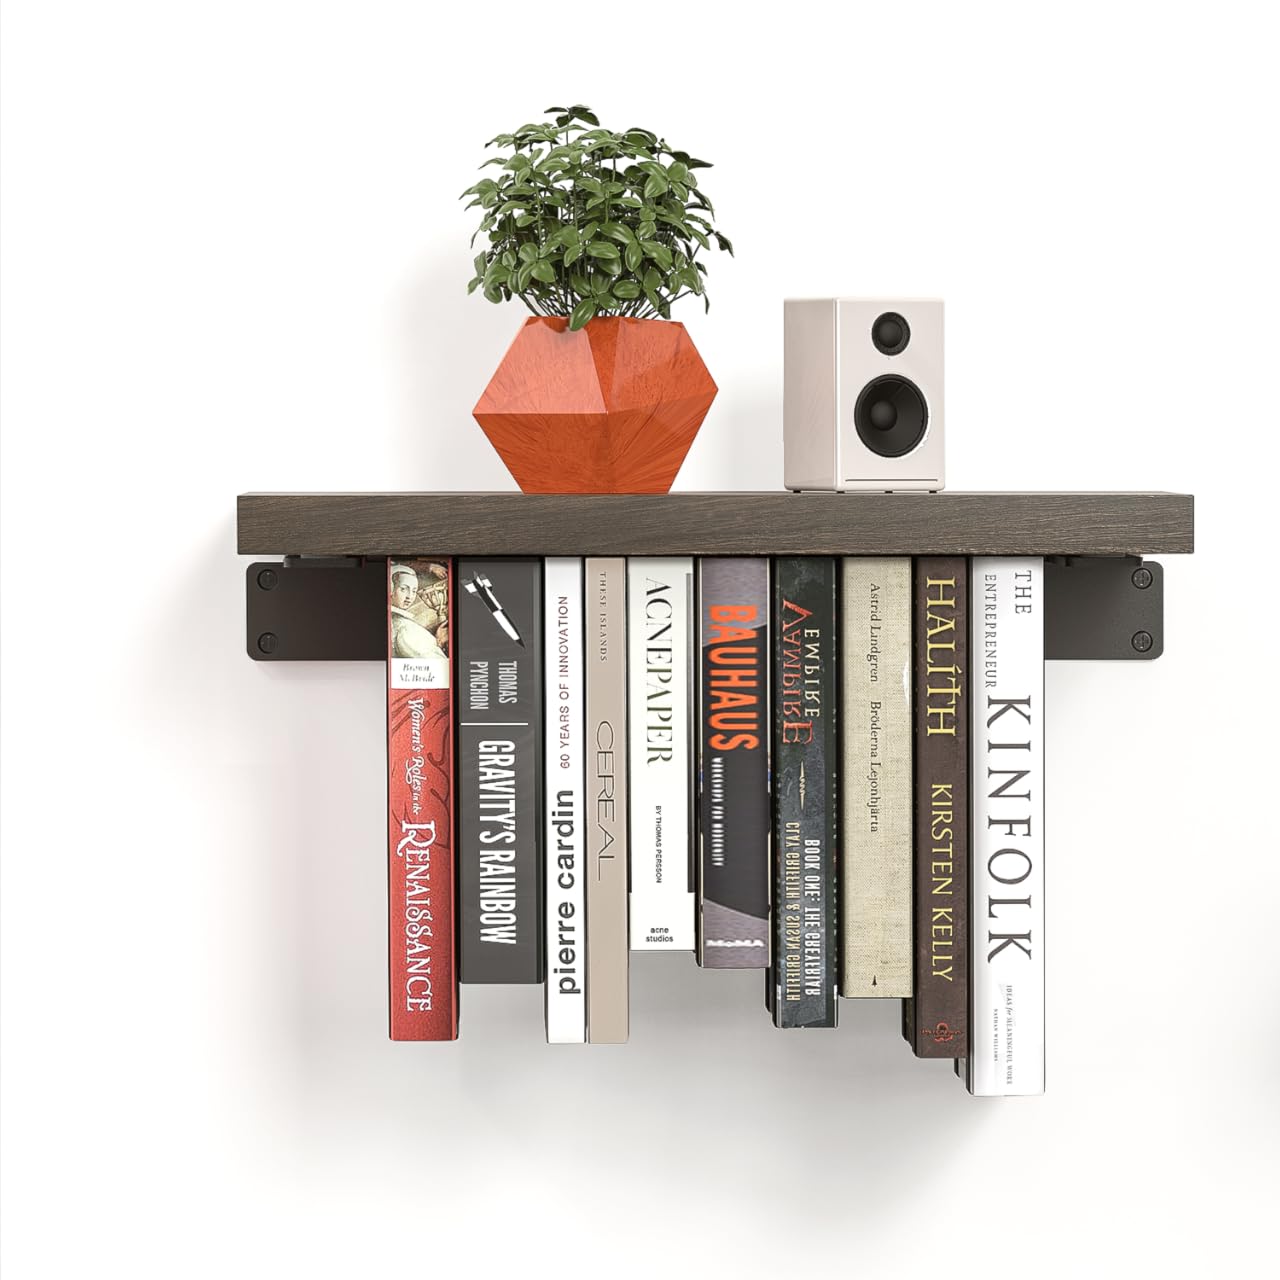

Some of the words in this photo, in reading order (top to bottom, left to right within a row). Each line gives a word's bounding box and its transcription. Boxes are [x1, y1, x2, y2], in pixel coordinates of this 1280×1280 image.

[599, 571, 607, 608] THESE
[870, 583, 882, 622] Astrid
[1014, 570, 1032, 614] THE
[558, 596, 569, 678] INNOVATION
[868, 626, 882, 682] Lindgren
[984, 574, 996, 688] ENTREPRENEUR
[470, 661, 489, 709] PYNCHON
[498, 661, 518, 703] THOMAS
[559, 683, 569, 700] OF
[645, 577, 673, 766] ACNEPAPER
[708, 604, 759, 750] BAUHAUS
[408, 697, 426, 752] Women's
[559, 706, 570, 748] YEARS
[870, 701, 882, 757] Bröderna
[405, 756, 426, 791] Roles
[561, 755, 570, 769] 60
[413, 792, 422, 801] in
[413, 803, 422, 815] the
[596, 721, 615, 881] CEREAL
[656, 805, 662, 815] BY
[711, 806, 724, 822] FOR
[867, 762, 882, 832] Lejonhjärta
[552, 791, 574, 889] cardin
[931, 784, 952, 895] KIRSTEN
[986, 695, 1033, 963] KINFOLK
[396, 820, 436, 1011] RENAISSANCE
[479, 849, 517, 944] RAINBOW
[554, 902, 582, 994] pierre
[931, 907, 952, 982] KELLY
[1005, 985, 1013, 1005] IDEAS
[1005, 1007, 1014, 1016] for
